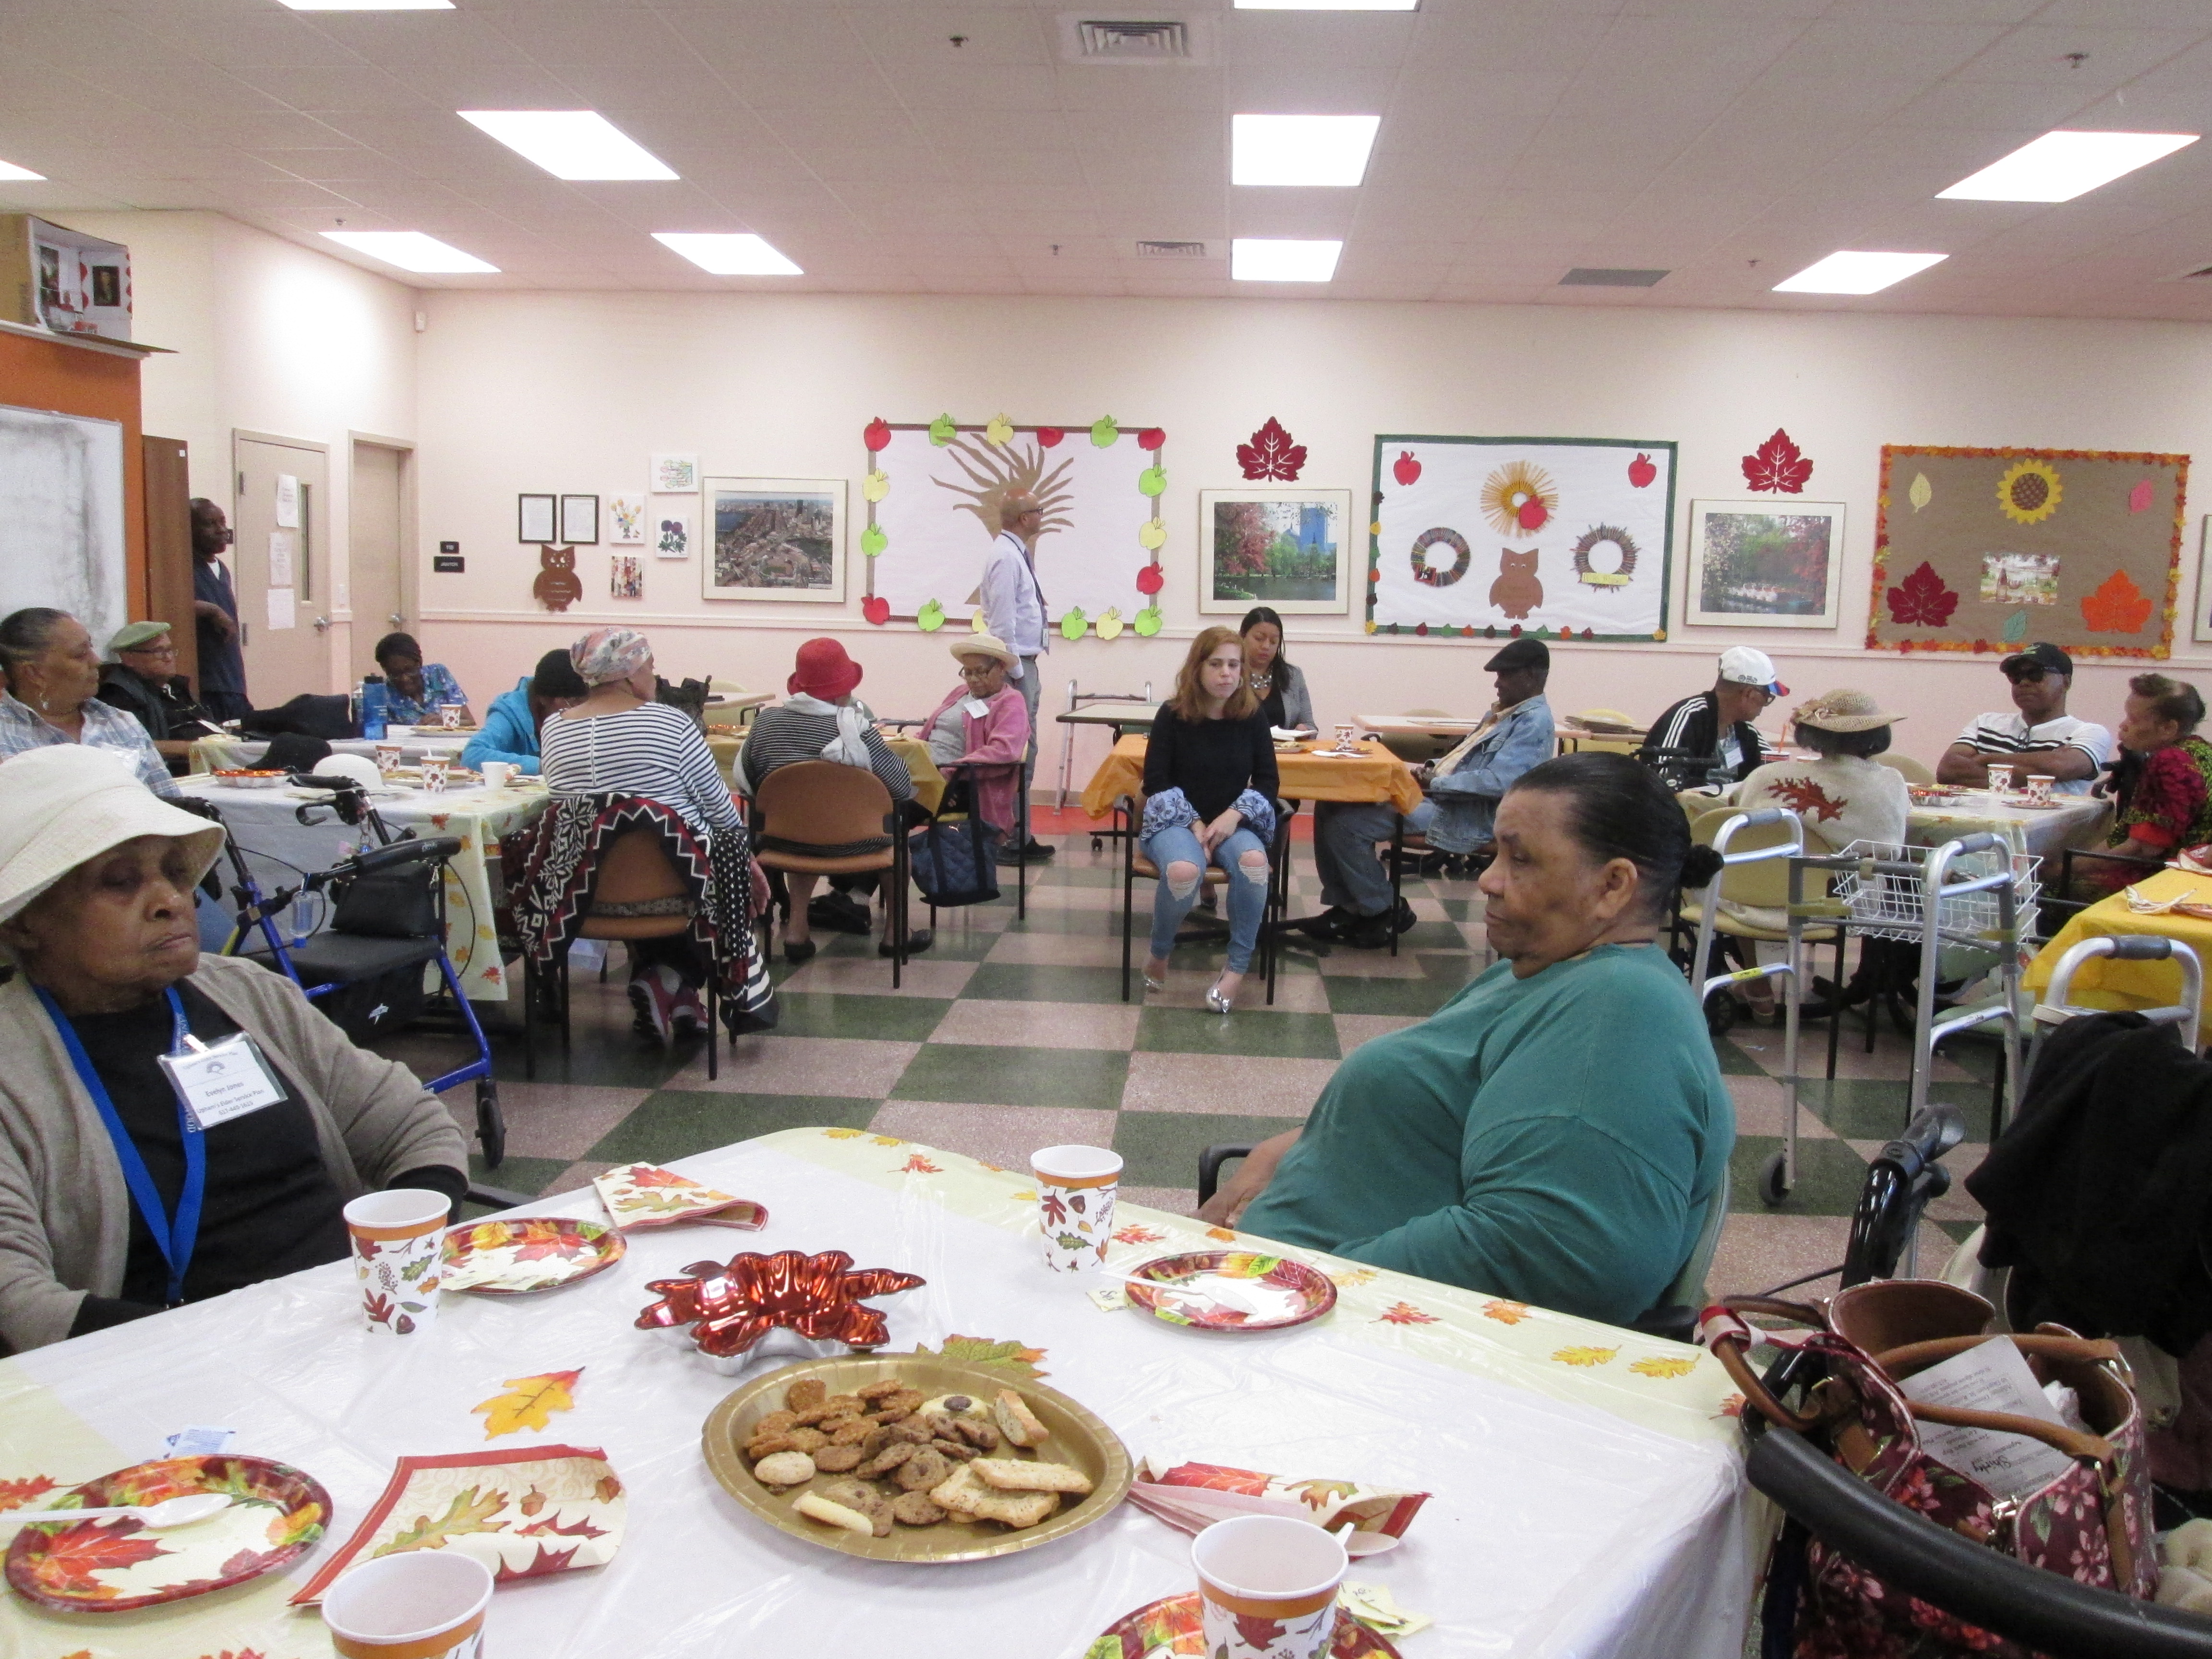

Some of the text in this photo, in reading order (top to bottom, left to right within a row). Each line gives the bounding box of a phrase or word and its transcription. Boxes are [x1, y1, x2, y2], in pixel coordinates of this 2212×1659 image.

[205, 1082, 244, 1097] Evelyn Jones
[234, 1093, 252, 1103] Service
